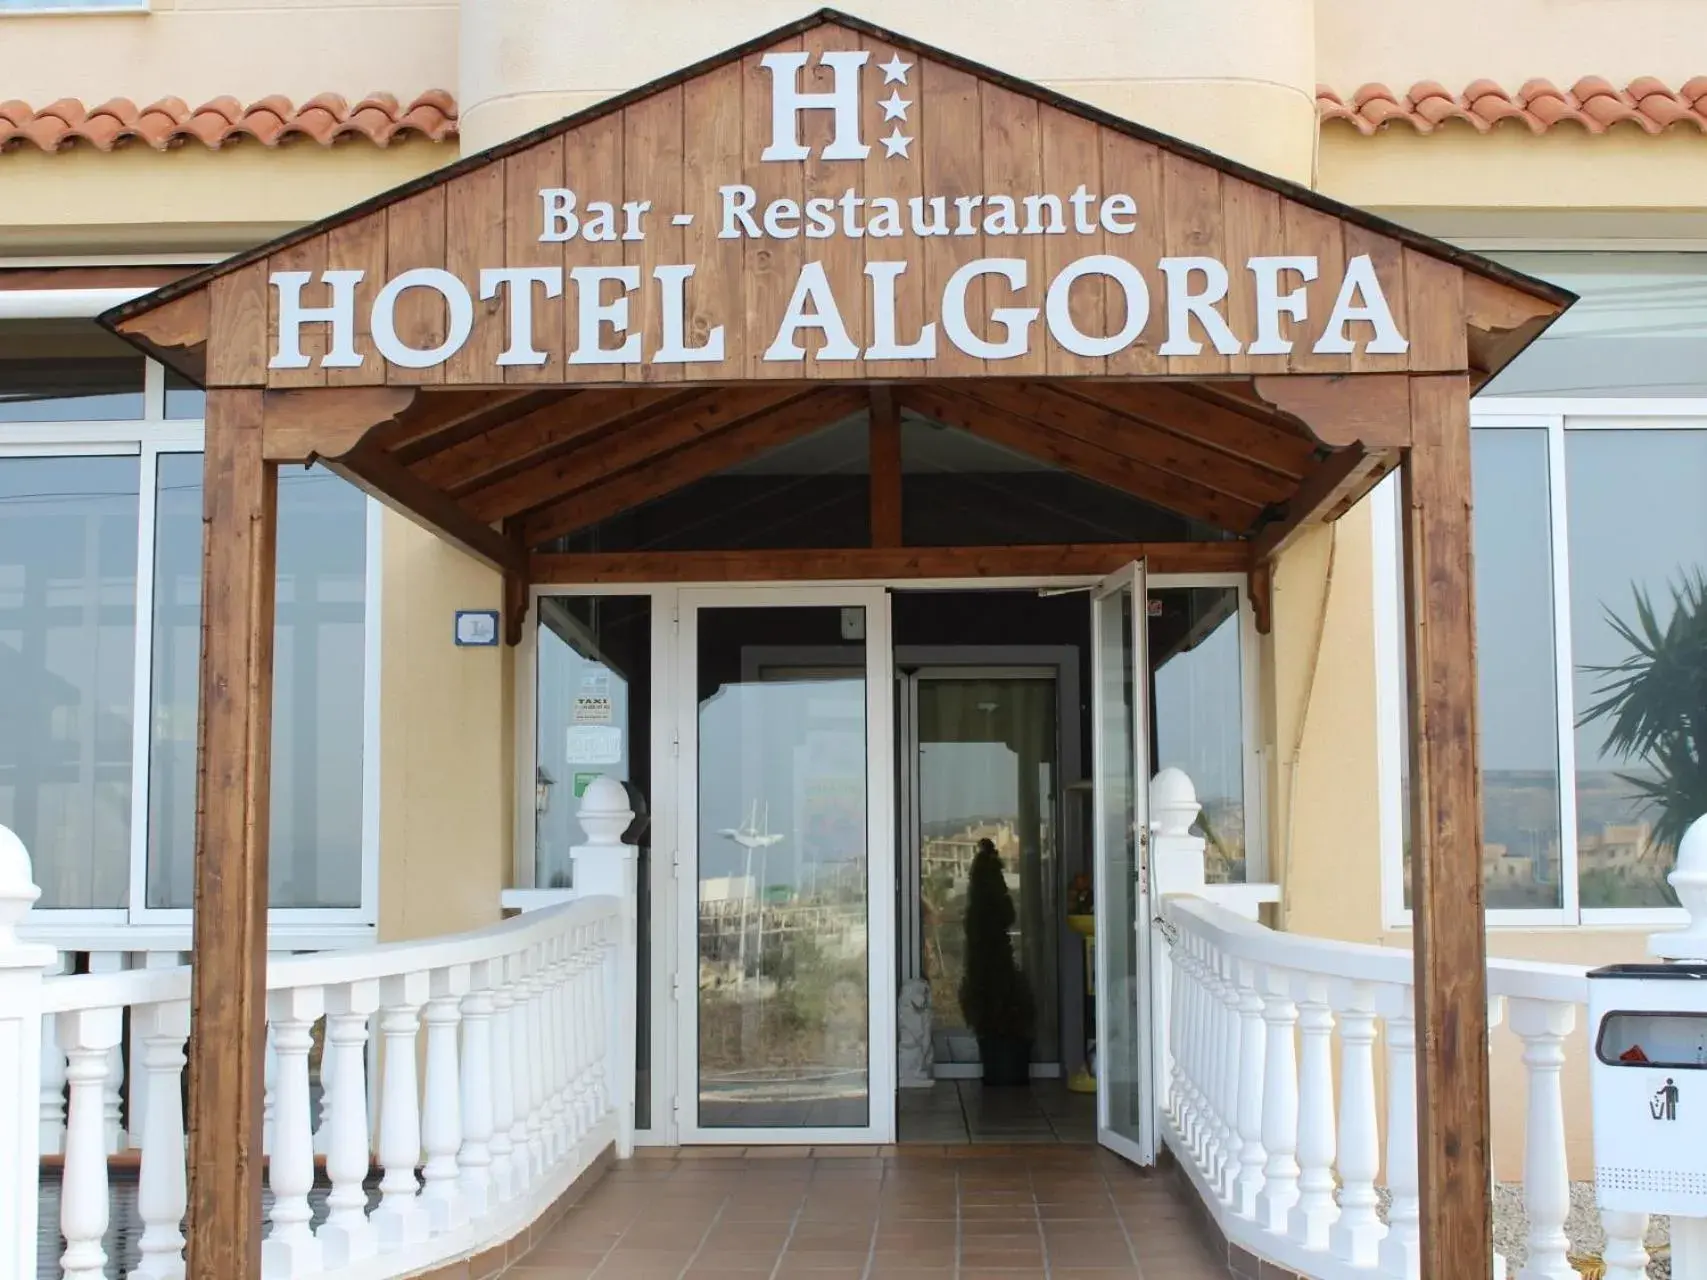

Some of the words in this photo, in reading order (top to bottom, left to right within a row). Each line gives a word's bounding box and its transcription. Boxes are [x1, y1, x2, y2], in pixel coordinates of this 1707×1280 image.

[760, 51, 871, 161] H
[538, 187, 652, 242] Bar
[671, 213, 695, 225] -
[717, 183, 1138, 240] Restaurante
[268, 263, 726, 369] HOTEL
[763, 254, 1410, 361] ALGORFA
